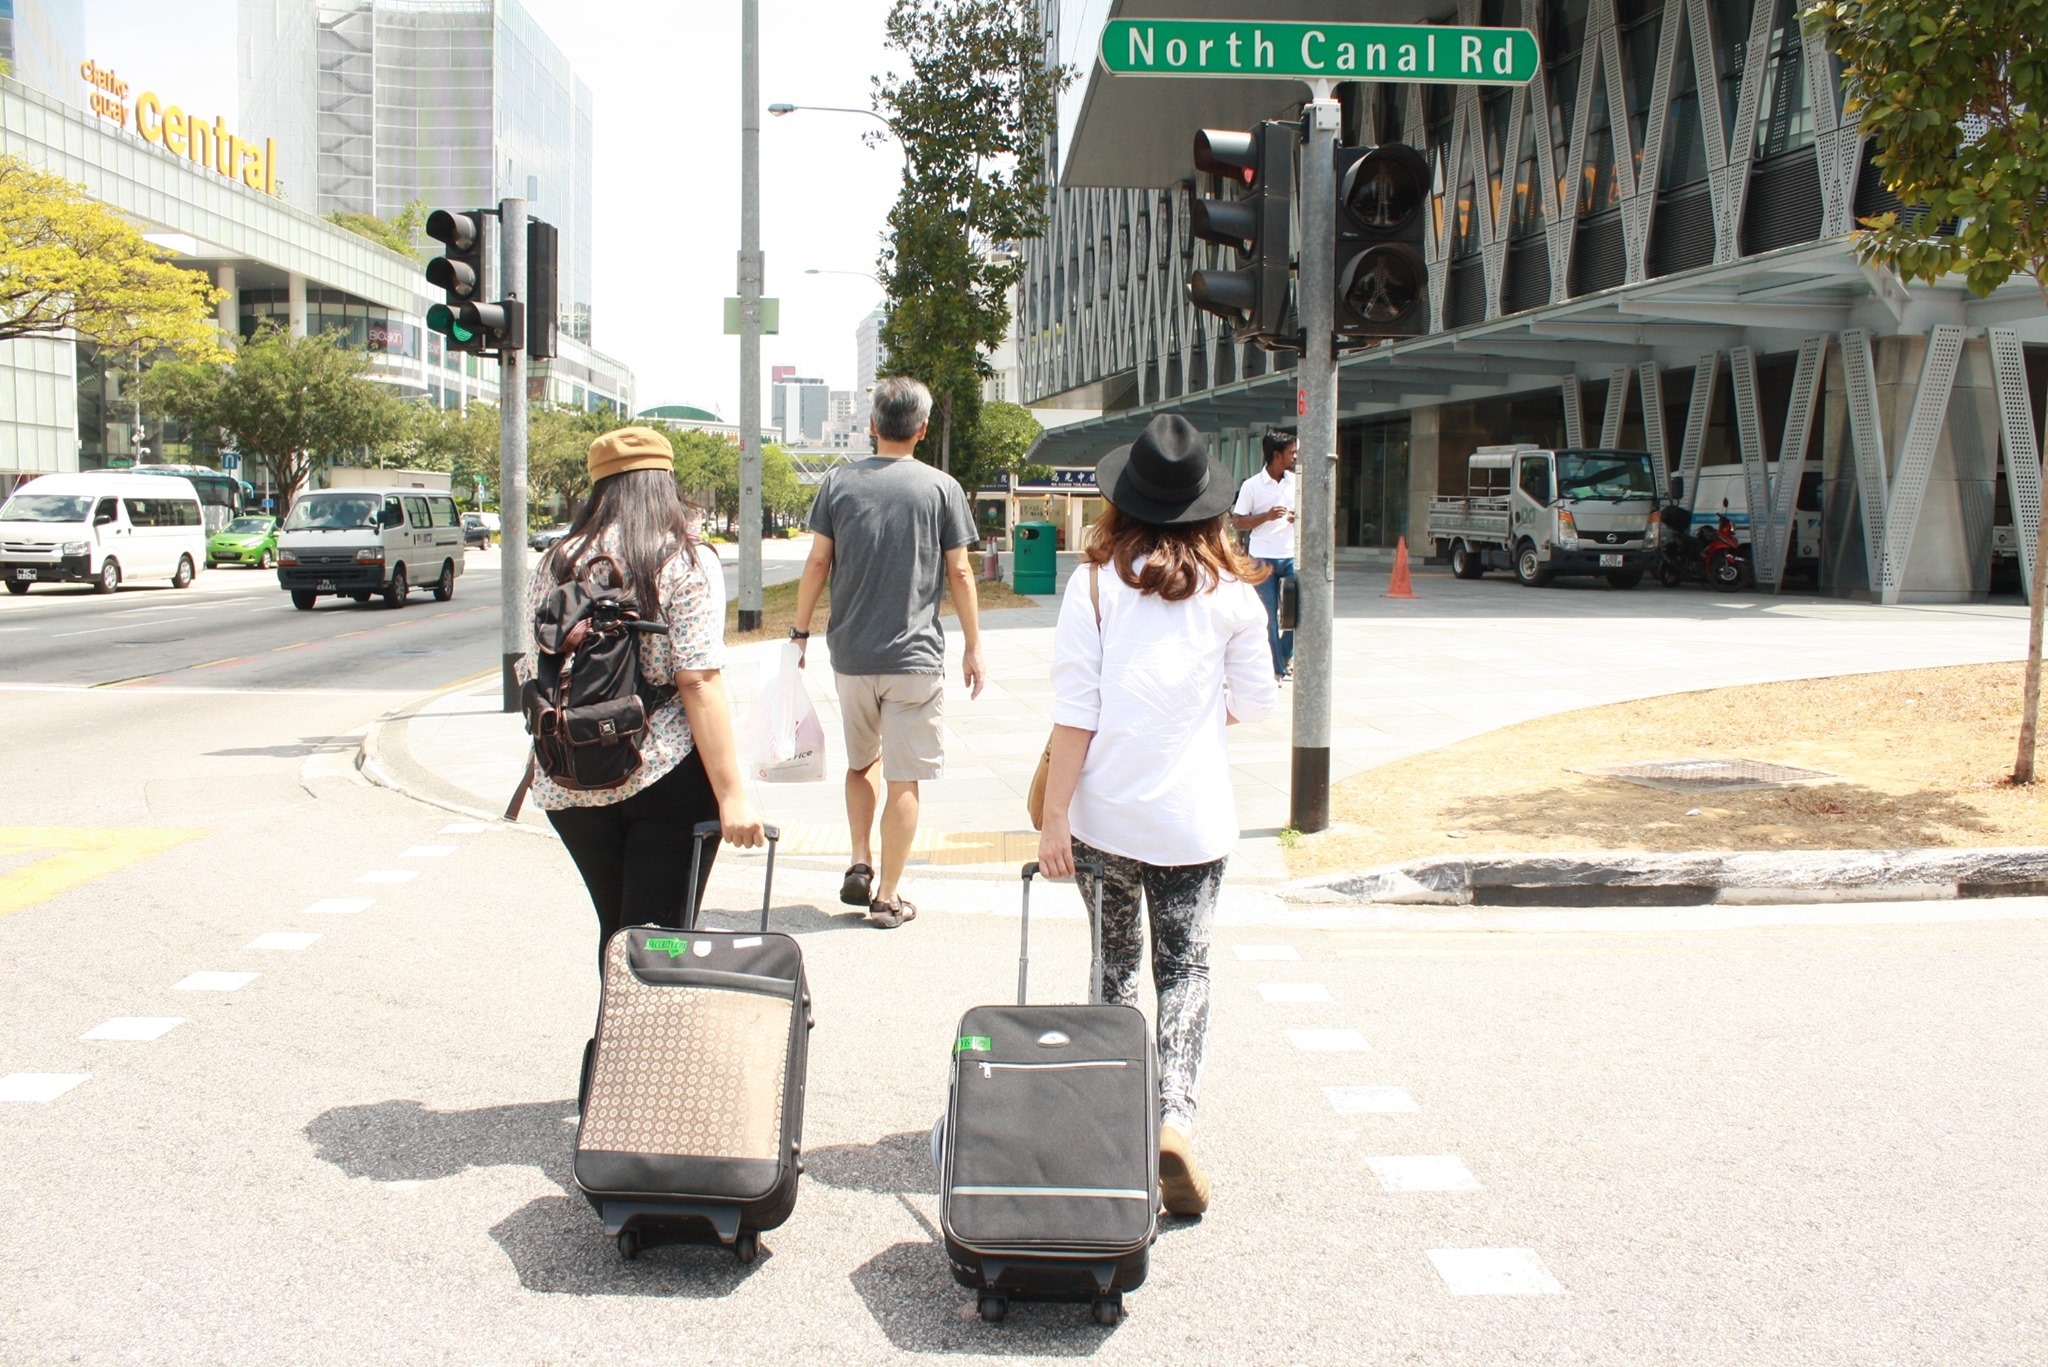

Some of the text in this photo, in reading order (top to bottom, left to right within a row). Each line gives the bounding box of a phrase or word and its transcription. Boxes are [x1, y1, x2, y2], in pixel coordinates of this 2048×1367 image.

[1128, 26, 1514, 75] North Canal Rd
[80, 59, 129, 100] clarke
[90, 91, 129, 128] quay
[135, 90, 277, 195] central
